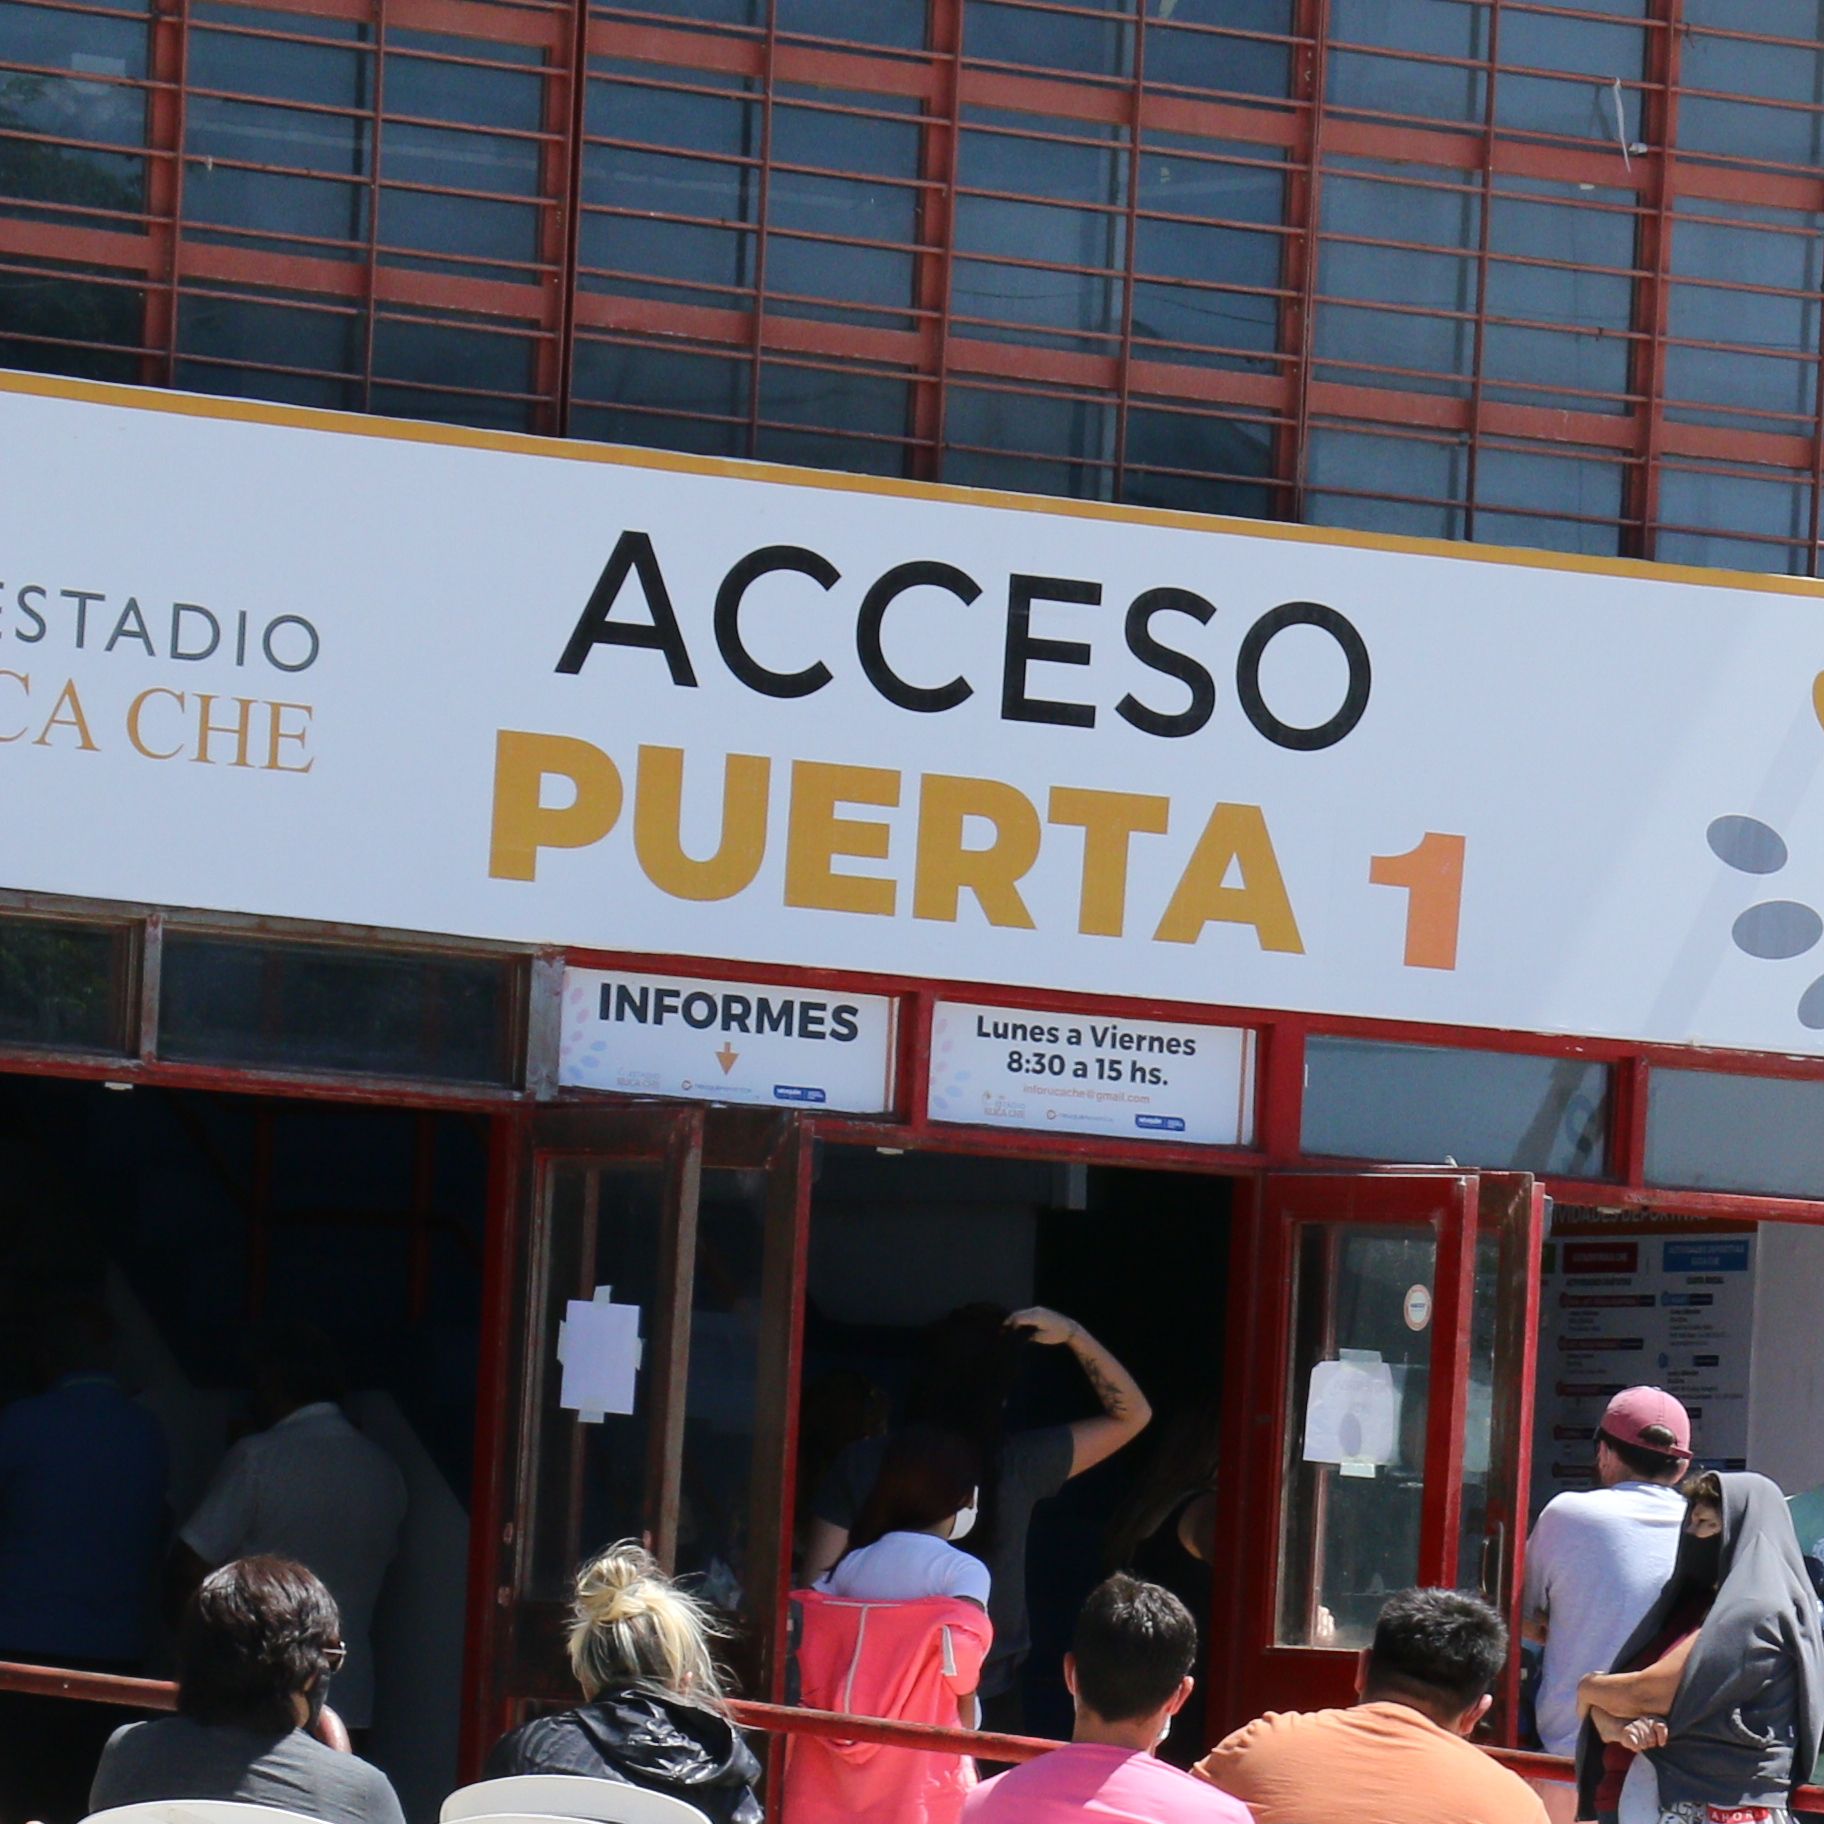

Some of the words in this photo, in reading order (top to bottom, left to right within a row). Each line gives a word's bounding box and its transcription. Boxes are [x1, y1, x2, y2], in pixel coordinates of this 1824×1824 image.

[0, 582, 319, 672] STADIO
[555, 529, 1372, 752] ACCESO
[126, 687, 314, 774] CHE
[488, 729, 1305, 955] PUERTA
[1369, 831, 1466, 971] 1
[599, 983, 859, 1042] INFORMES
[976, 1014, 1060, 1044] Lunes
[1066, 1027, 1082, 1046] a
[1089, 1023, 1197, 1056] Viernes
[1006, 1050, 1066, 1076] 8:30
[1072, 1060, 1088, 1079] a
[1095, 1057, 1123, 1082] 15
[1130, 1059, 1168, 1086] hs.
